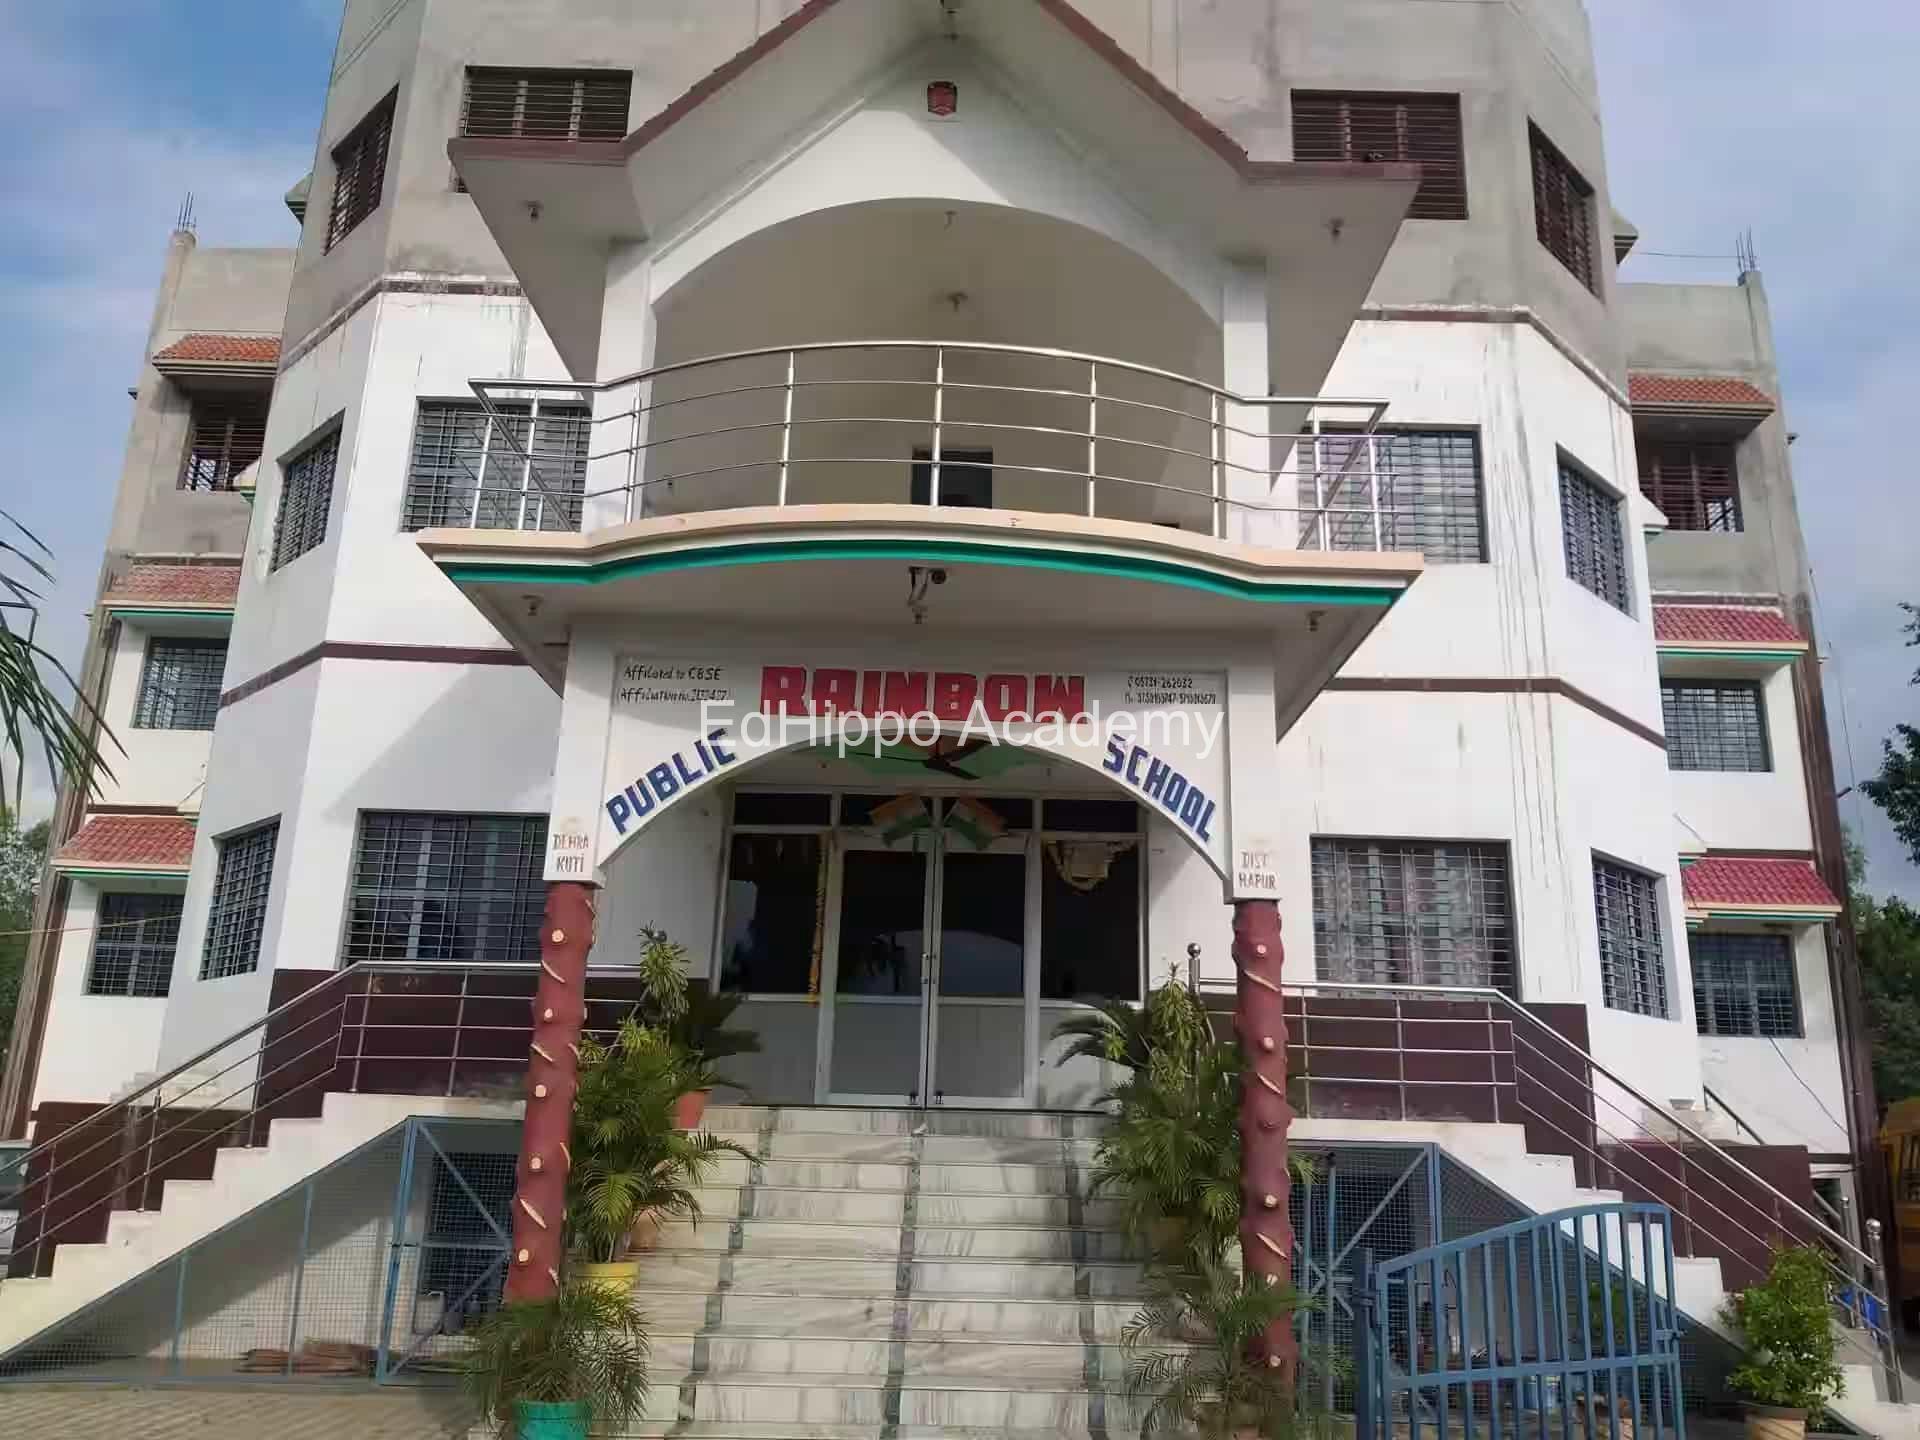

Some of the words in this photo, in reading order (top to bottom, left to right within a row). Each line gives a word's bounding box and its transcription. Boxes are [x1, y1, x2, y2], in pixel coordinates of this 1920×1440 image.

[688, 666, 723, 681] CBSE
[760, 665, 1088, 724] RAINBOW
[606, 728, 736, 835] PUBLIC
[1102, 733, 1216, 842] SCHOOL
[1238, 872, 1277, 891] HAPUR
